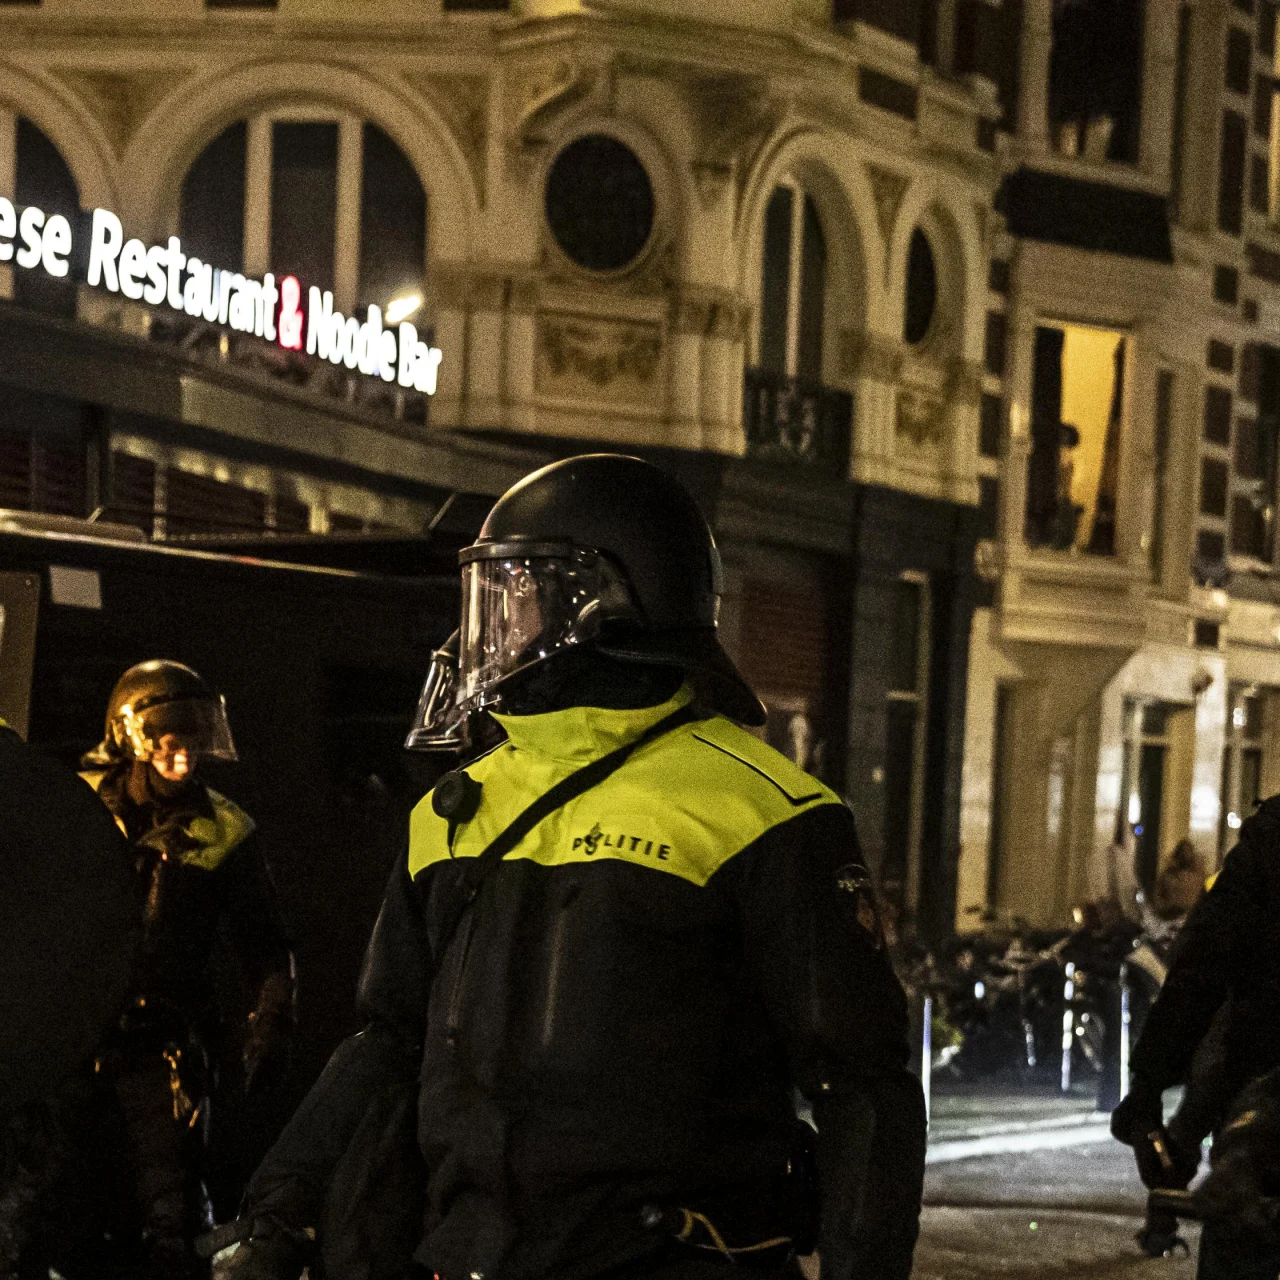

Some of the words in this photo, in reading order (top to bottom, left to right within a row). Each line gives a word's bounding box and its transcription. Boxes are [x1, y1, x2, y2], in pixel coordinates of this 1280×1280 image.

[87, 207, 279, 341] Restaurant
[278, 275, 304, 351] &
[306, 286, 398, 382] Noodle
[398, 321, 443, 395] Bar
[572, 822, 672, 861] POLITIE
